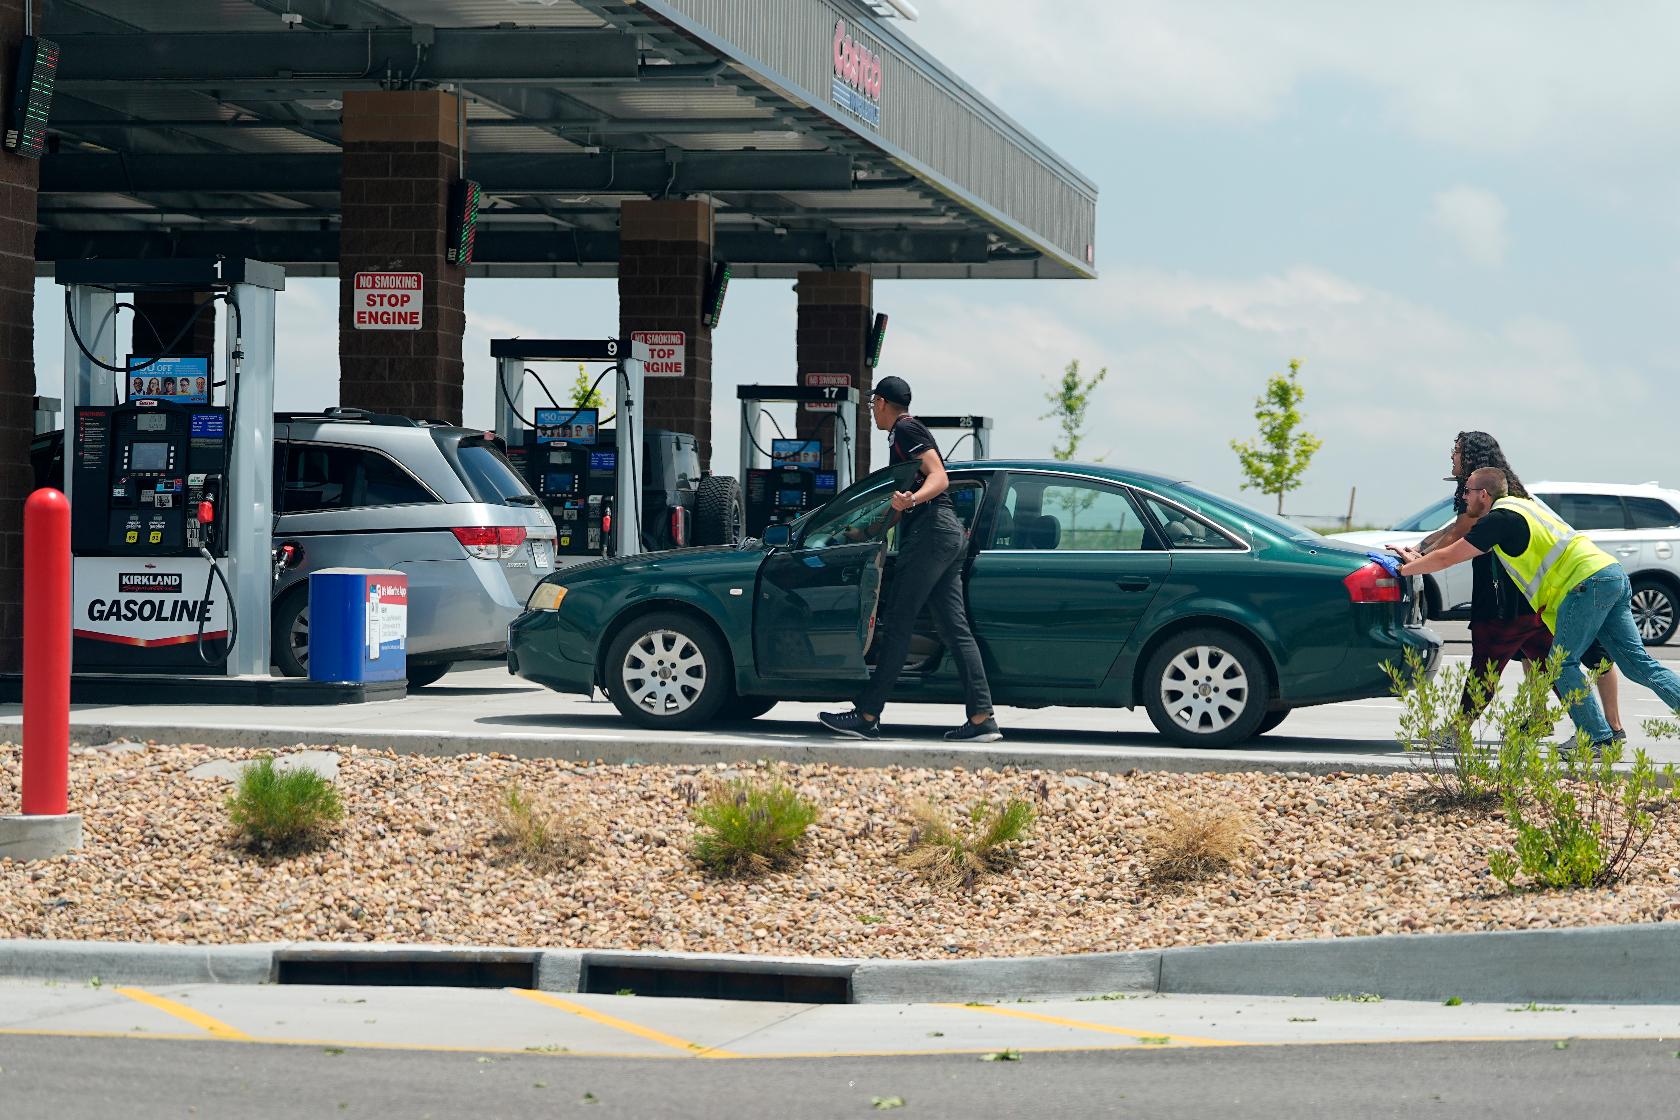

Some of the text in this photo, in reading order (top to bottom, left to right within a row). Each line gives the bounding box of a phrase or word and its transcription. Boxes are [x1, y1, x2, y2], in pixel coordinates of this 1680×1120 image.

[213, 260, 222, 279] 1
[359, 275, 418, 289] NO SMOKING
[366, 293, 411, 308] STOP
[356, 310, 420, 325] ENGINE
[647, 334, 681, 345] SMOKING
[607, 341, 618, 356] 9
[649, 348, 675, 359] TOP
[644, 362, 682, 373] NGINE
[823, 387, 839, 399] 17
[122, 575, 180, 586] KIRKLAND
[88, 598, 214, 622] GASOLINE
